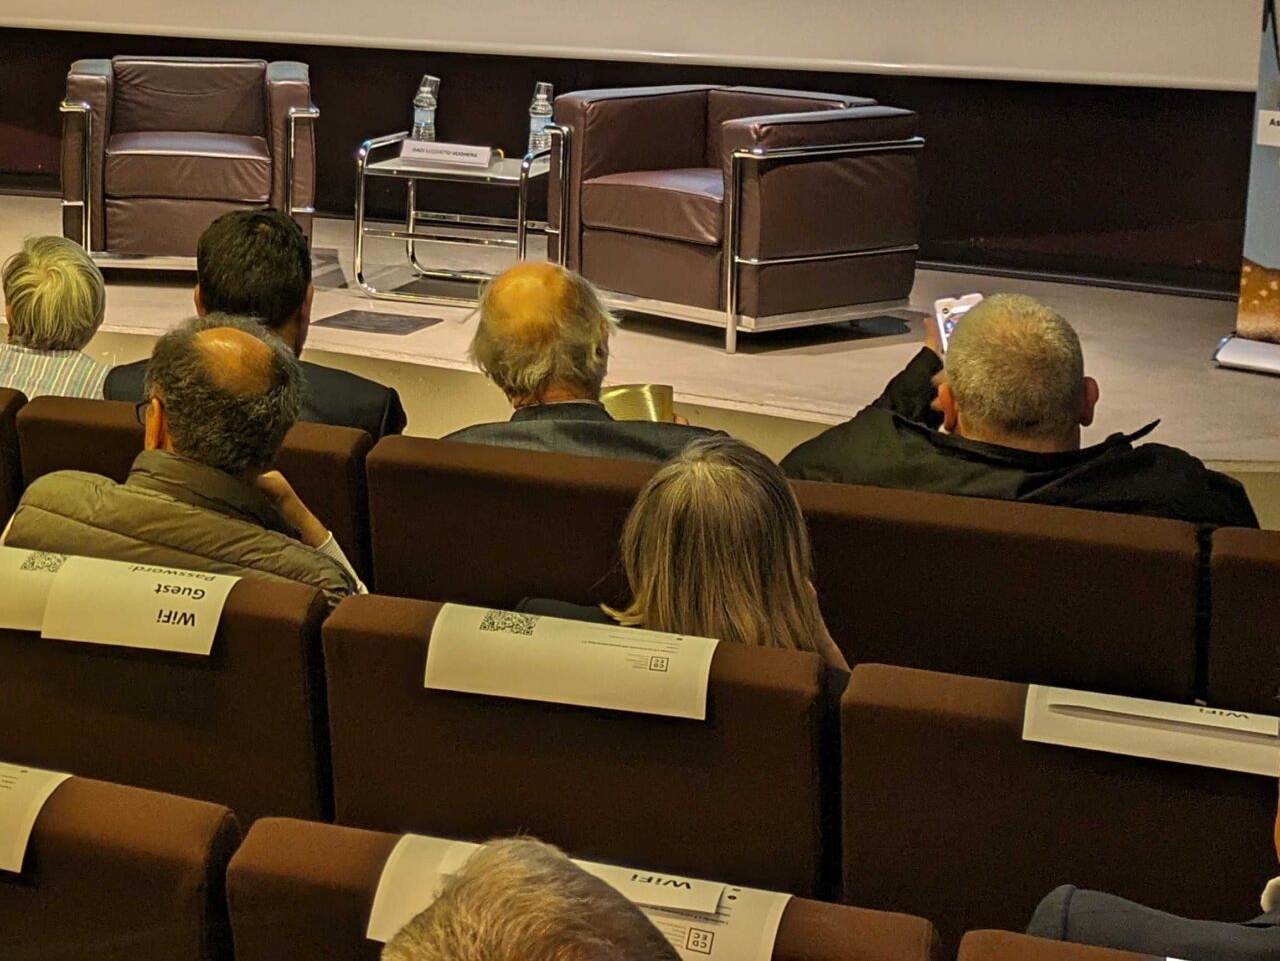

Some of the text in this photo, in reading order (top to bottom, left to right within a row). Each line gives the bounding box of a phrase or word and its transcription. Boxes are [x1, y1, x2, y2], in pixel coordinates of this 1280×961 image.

[127, 565, 217, 582] Password:
[154, 583, 207, 600] Guest
[156, 609, 196, 627] WiFi
[631, 874, 692, 890] WiFi
